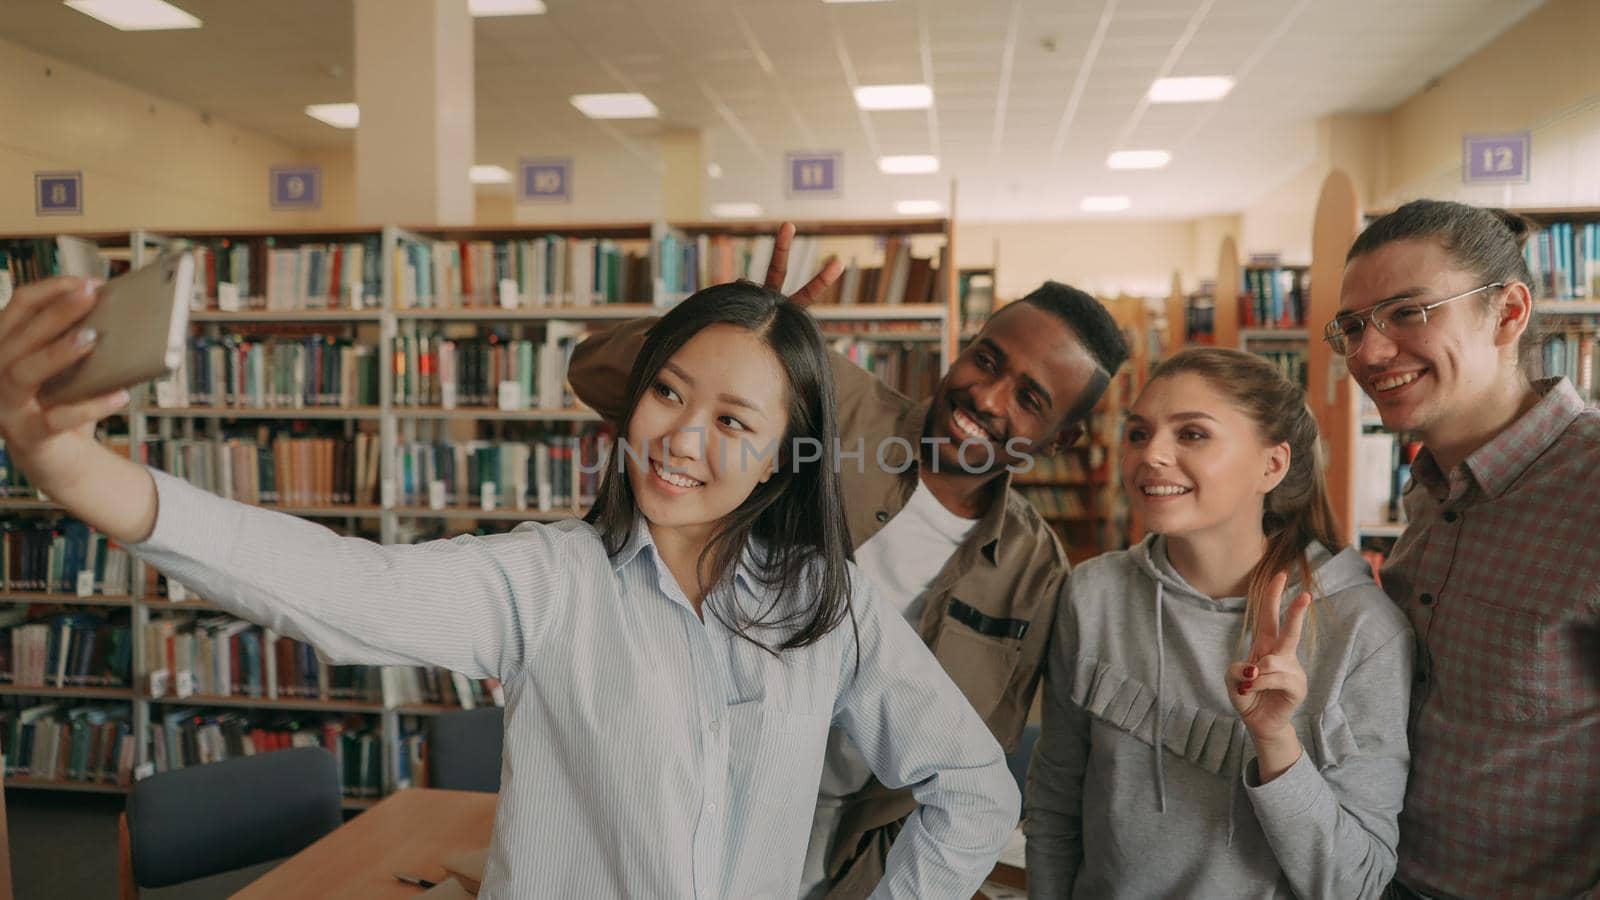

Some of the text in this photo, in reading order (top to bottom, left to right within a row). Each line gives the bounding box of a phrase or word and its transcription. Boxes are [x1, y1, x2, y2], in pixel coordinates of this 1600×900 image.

[1484, 147, 1513, 171] 12
[534, 170, 561, 192] 10
[801, 163, 824, 186] 11
